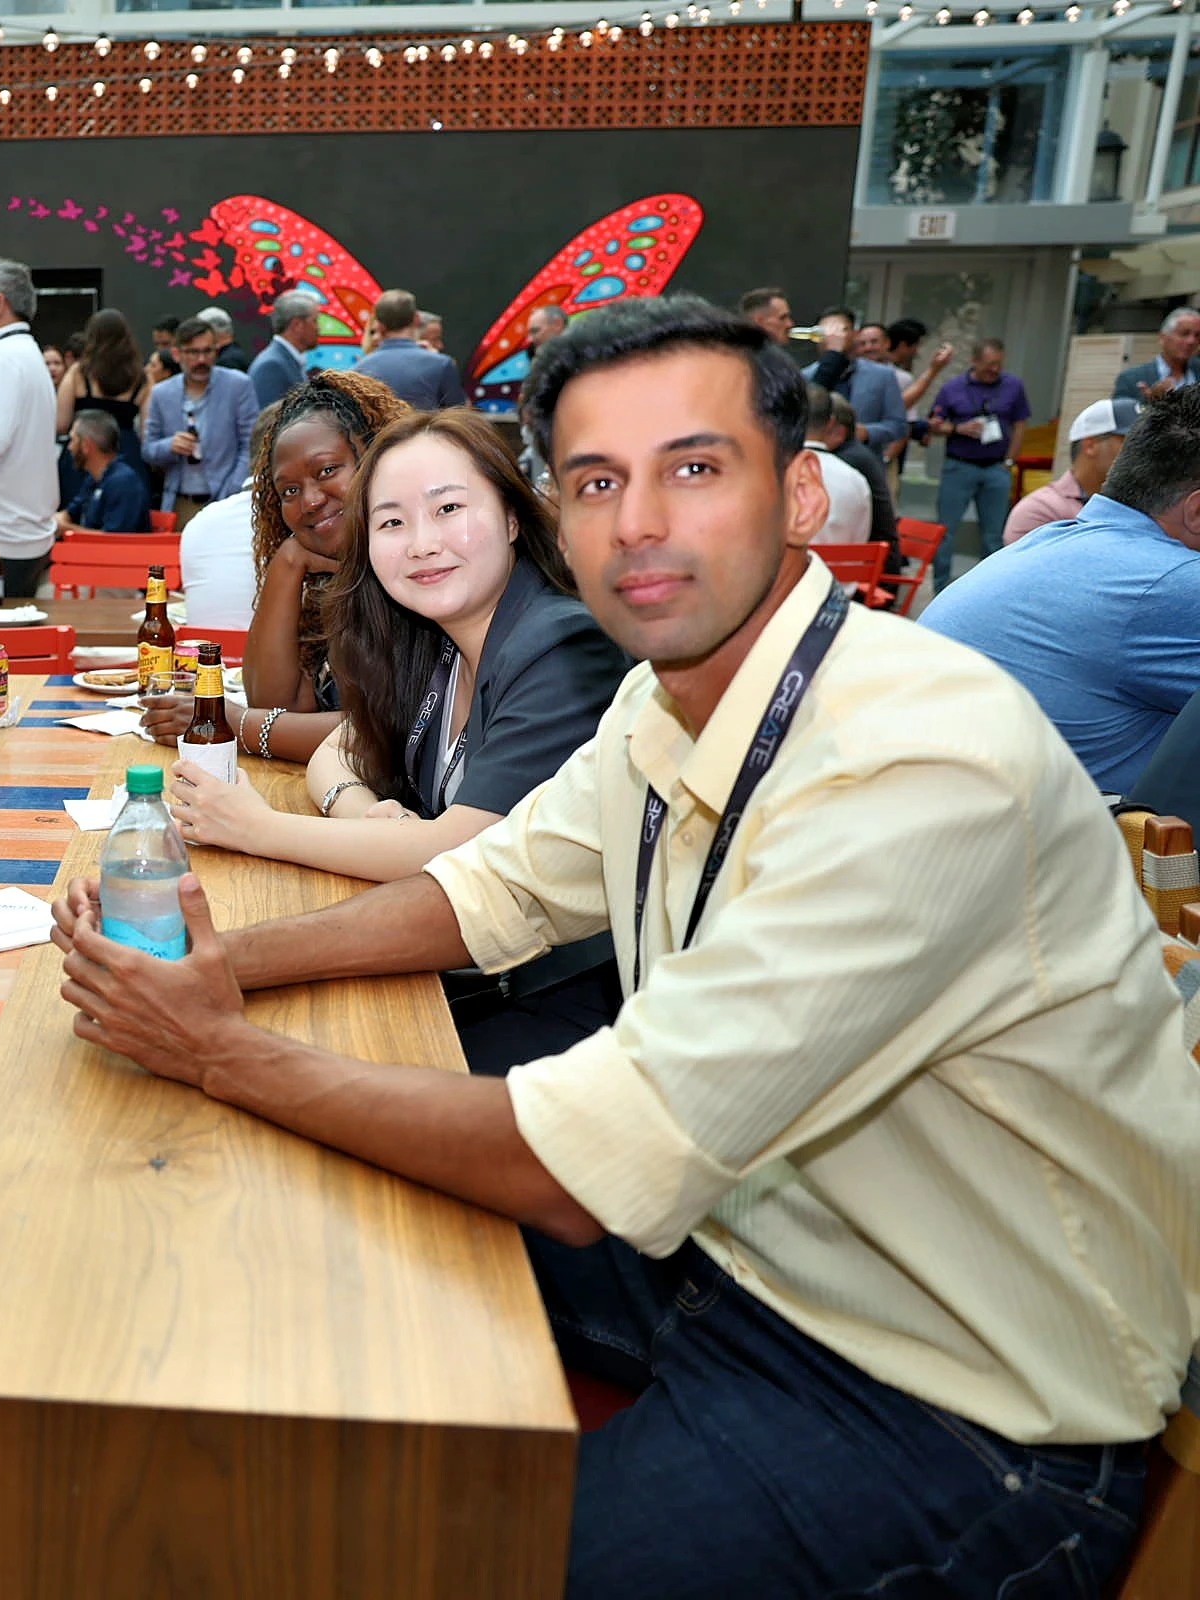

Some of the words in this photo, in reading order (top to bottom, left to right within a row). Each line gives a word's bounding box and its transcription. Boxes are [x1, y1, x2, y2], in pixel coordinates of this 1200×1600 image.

[920, 215, 946, 236] EXIT
[409, 691, 438, 745] CREATE
[749, 670, 804, 768] CREATE
[644, 798, 663, 843] CRE
